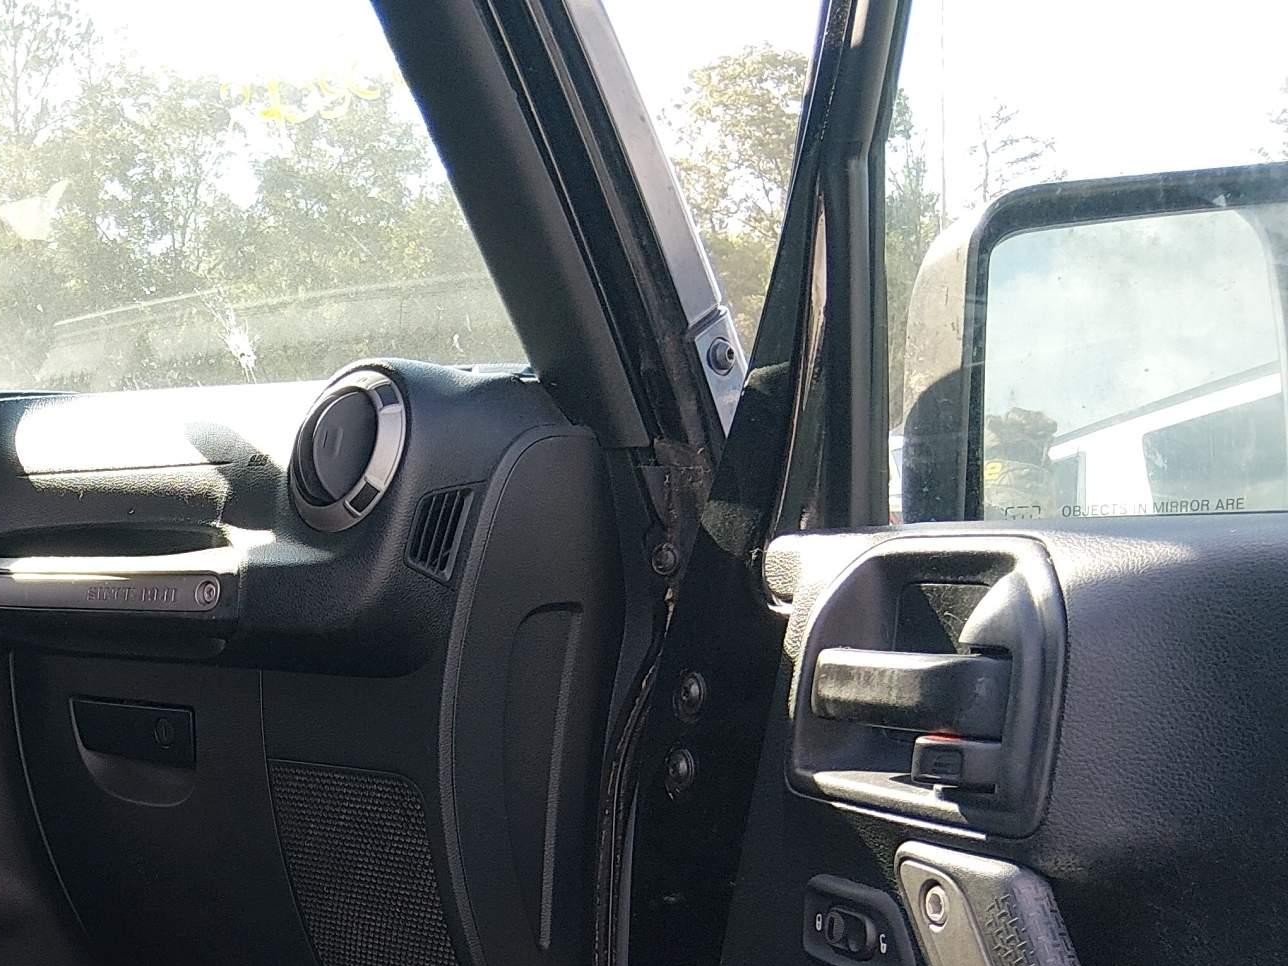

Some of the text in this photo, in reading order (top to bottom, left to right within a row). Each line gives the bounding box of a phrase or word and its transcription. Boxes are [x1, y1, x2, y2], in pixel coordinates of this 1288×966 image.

[1061, 497, 1245, 518] OBJECTS IN MIRROR ARE
